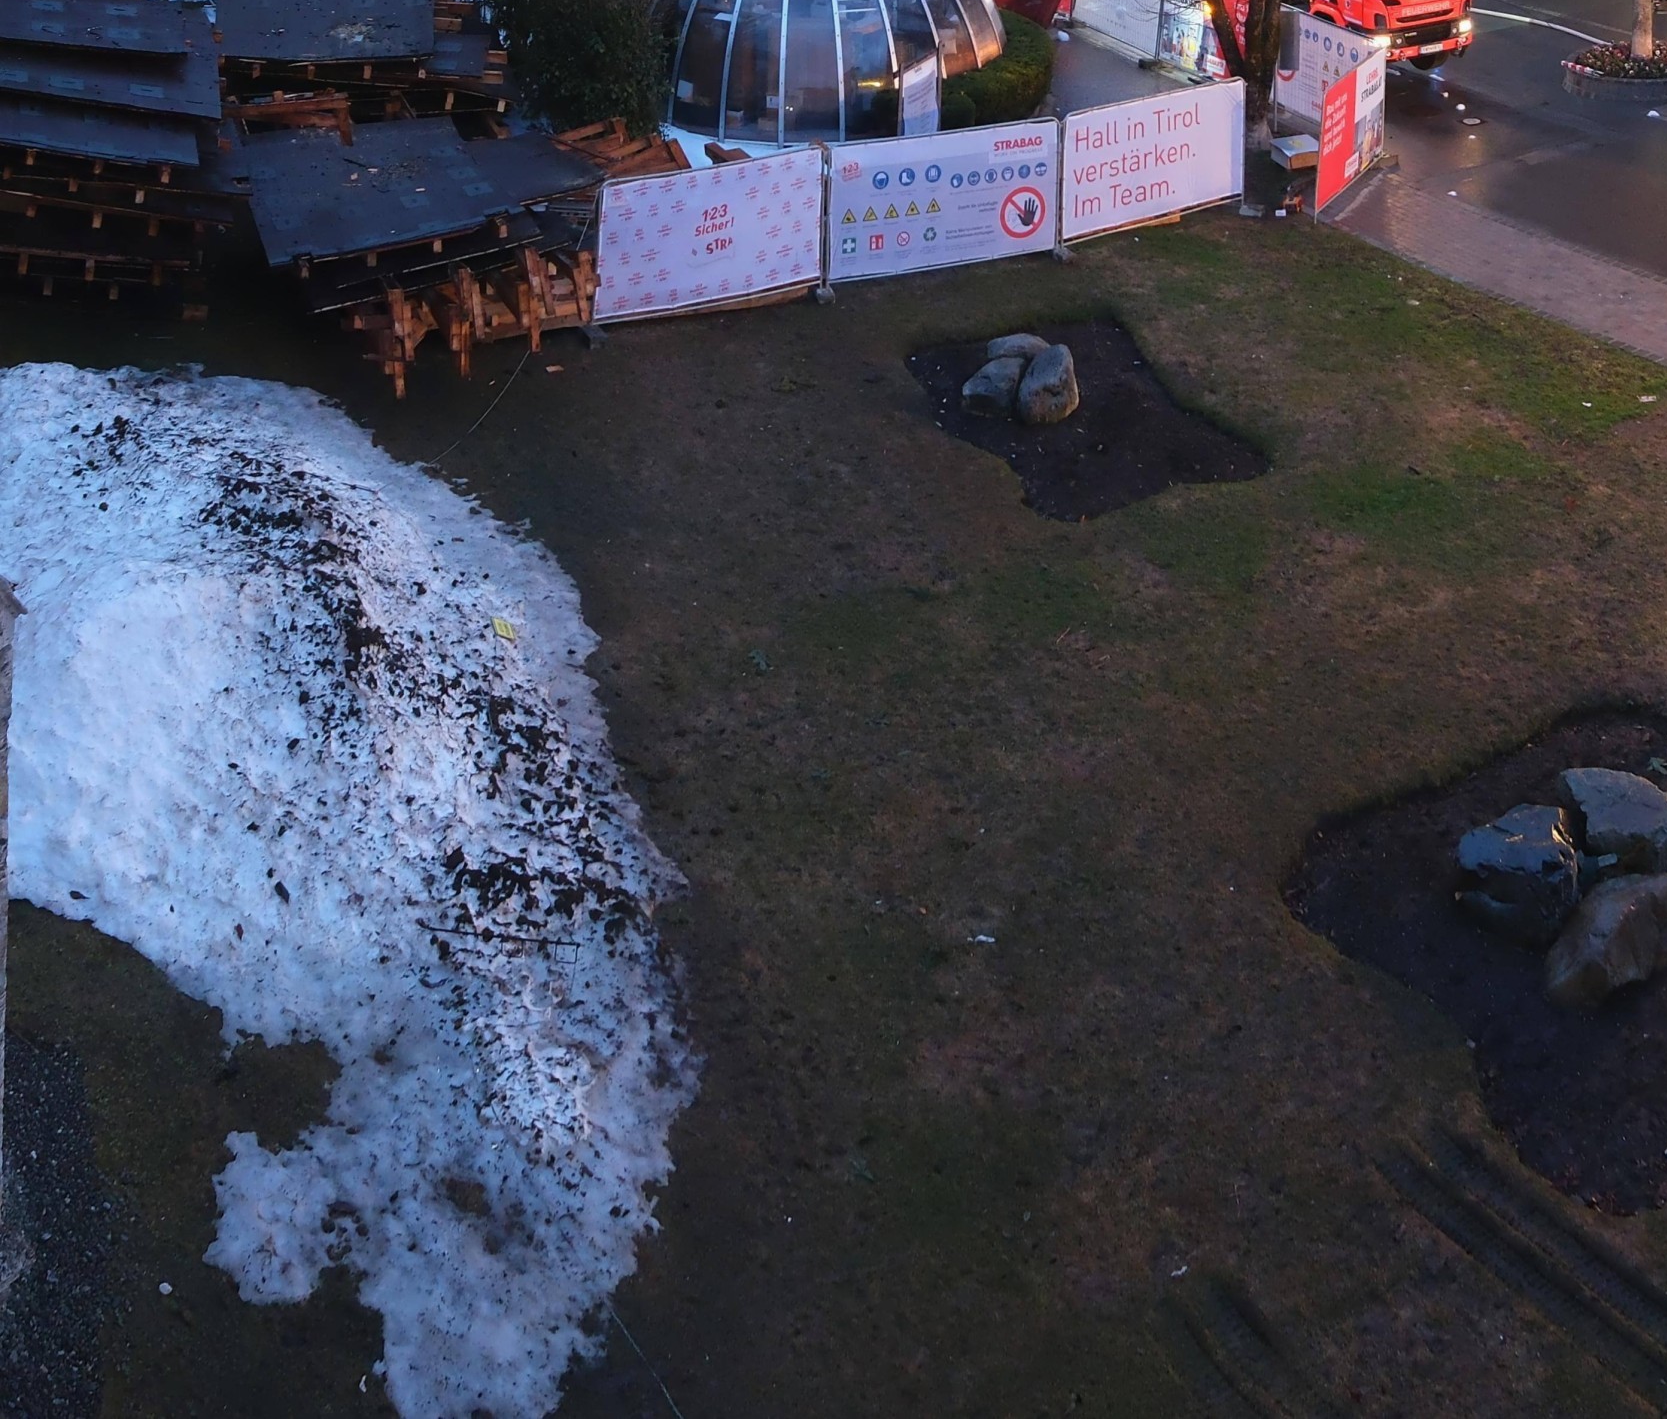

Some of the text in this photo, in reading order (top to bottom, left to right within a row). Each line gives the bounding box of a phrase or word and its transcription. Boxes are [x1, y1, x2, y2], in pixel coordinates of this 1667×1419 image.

[1402, 1, 1450, 17] FEUERWEHR
[1075, 102, 1201, 152] Hall in Tirol
[993, 136, 1043, 152] STRABAG
[1073, 142, 1197, 185] verstärken.
[1074, 180, 1176, 218] Im Team.
[694, 217, 735, 237] Sicher!
